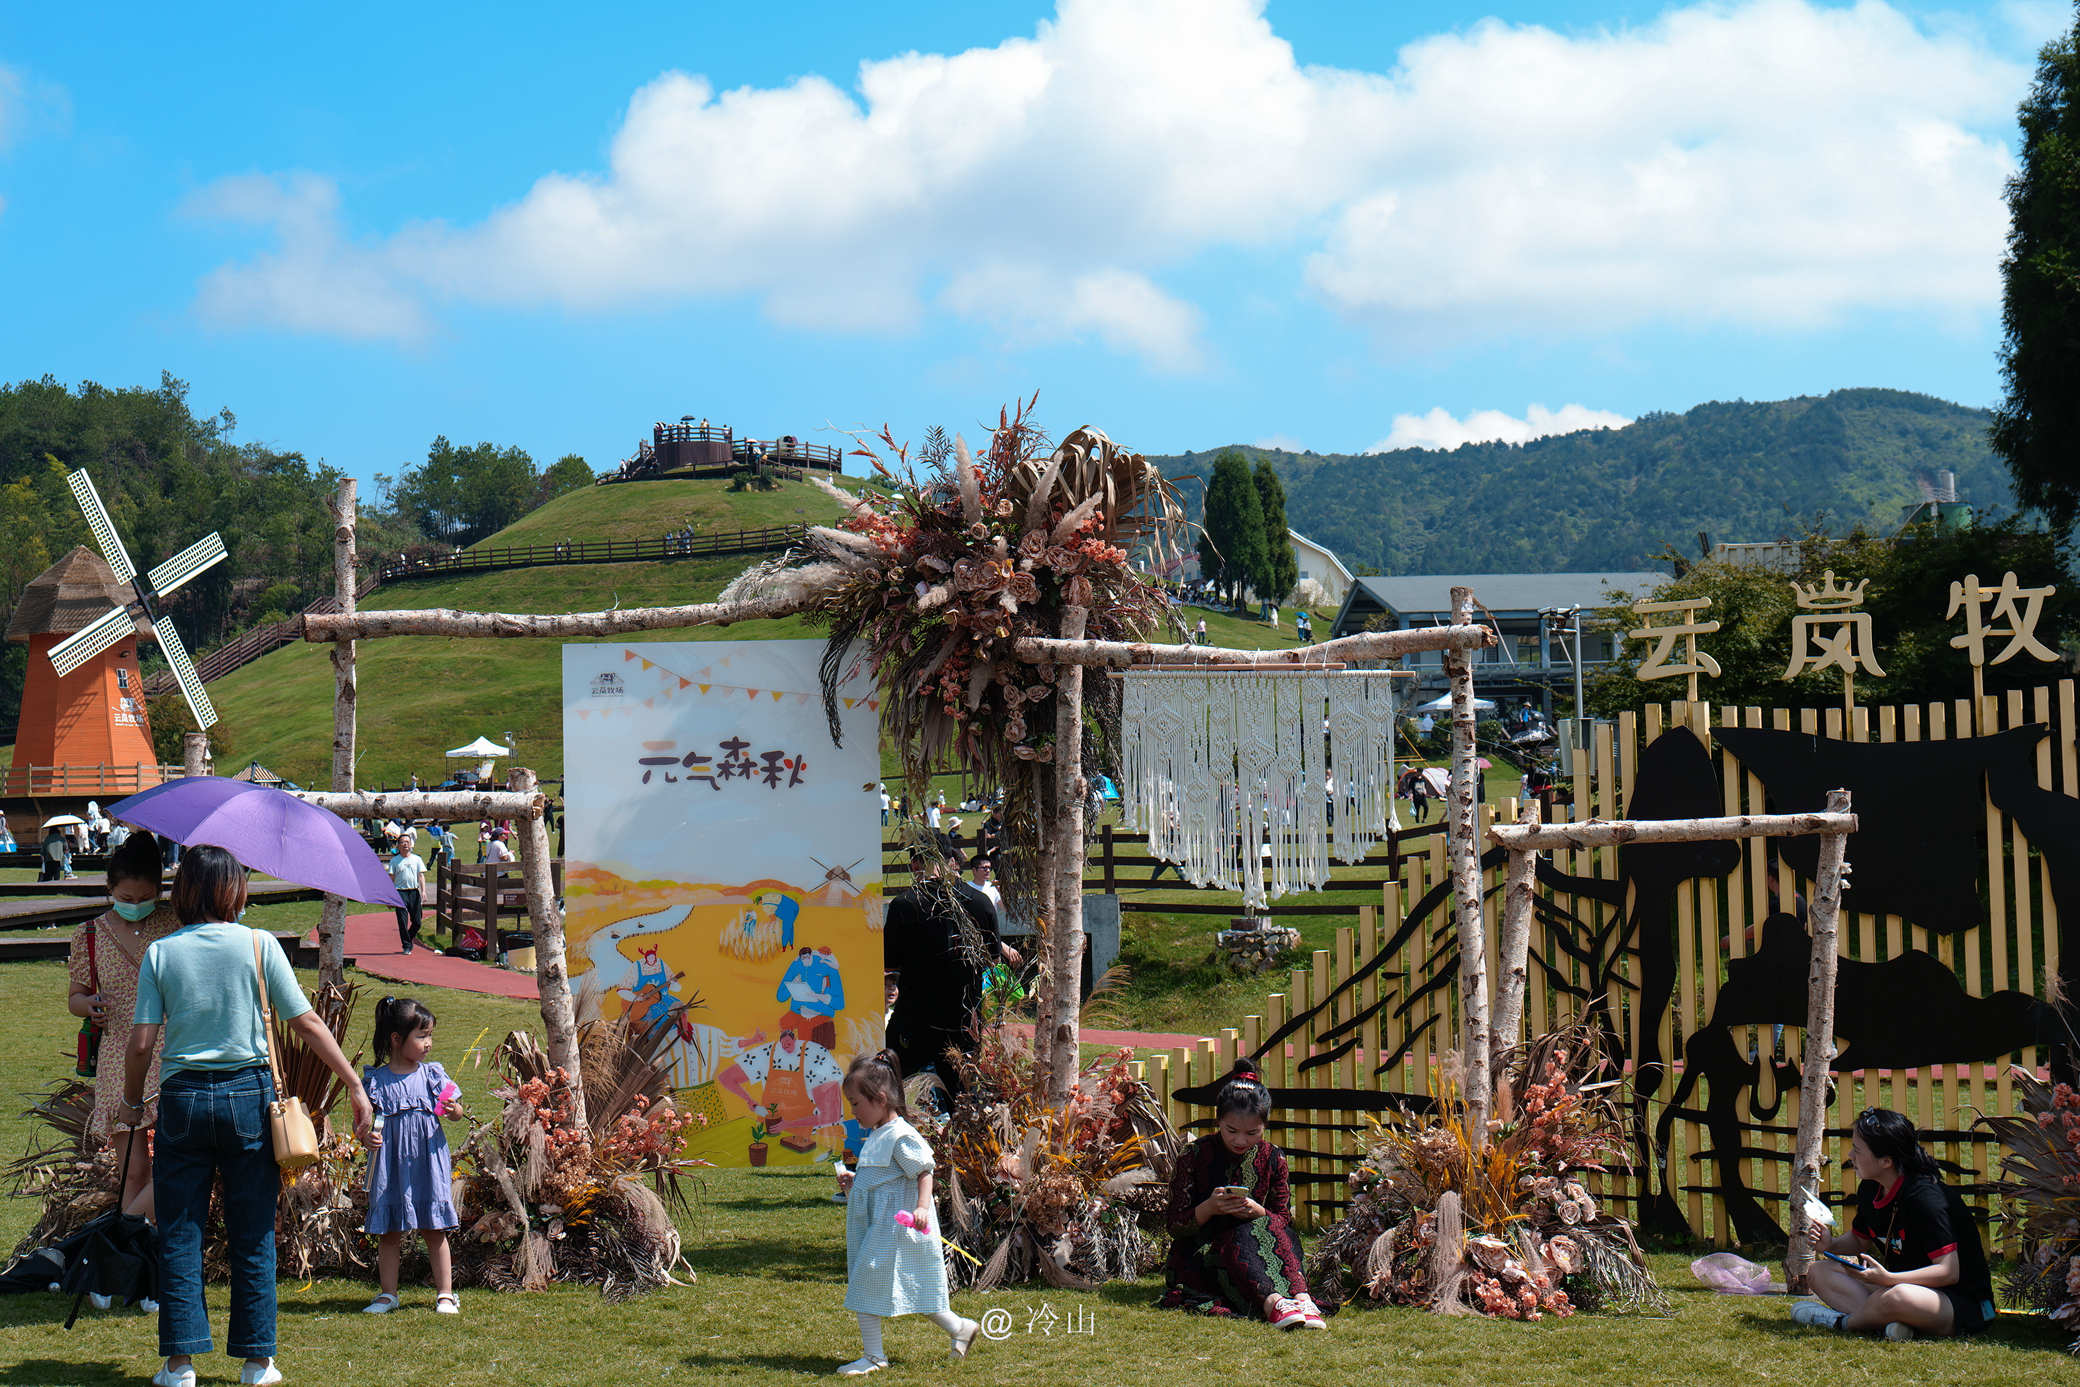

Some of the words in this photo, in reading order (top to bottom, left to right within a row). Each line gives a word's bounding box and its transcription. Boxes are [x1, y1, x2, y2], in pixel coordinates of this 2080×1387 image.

[1629, 570, 2061, 681] 云岚牧
[591, 686, 624, 694] 云岚牧场
[638, 736, 807, 791] 元气森秋
